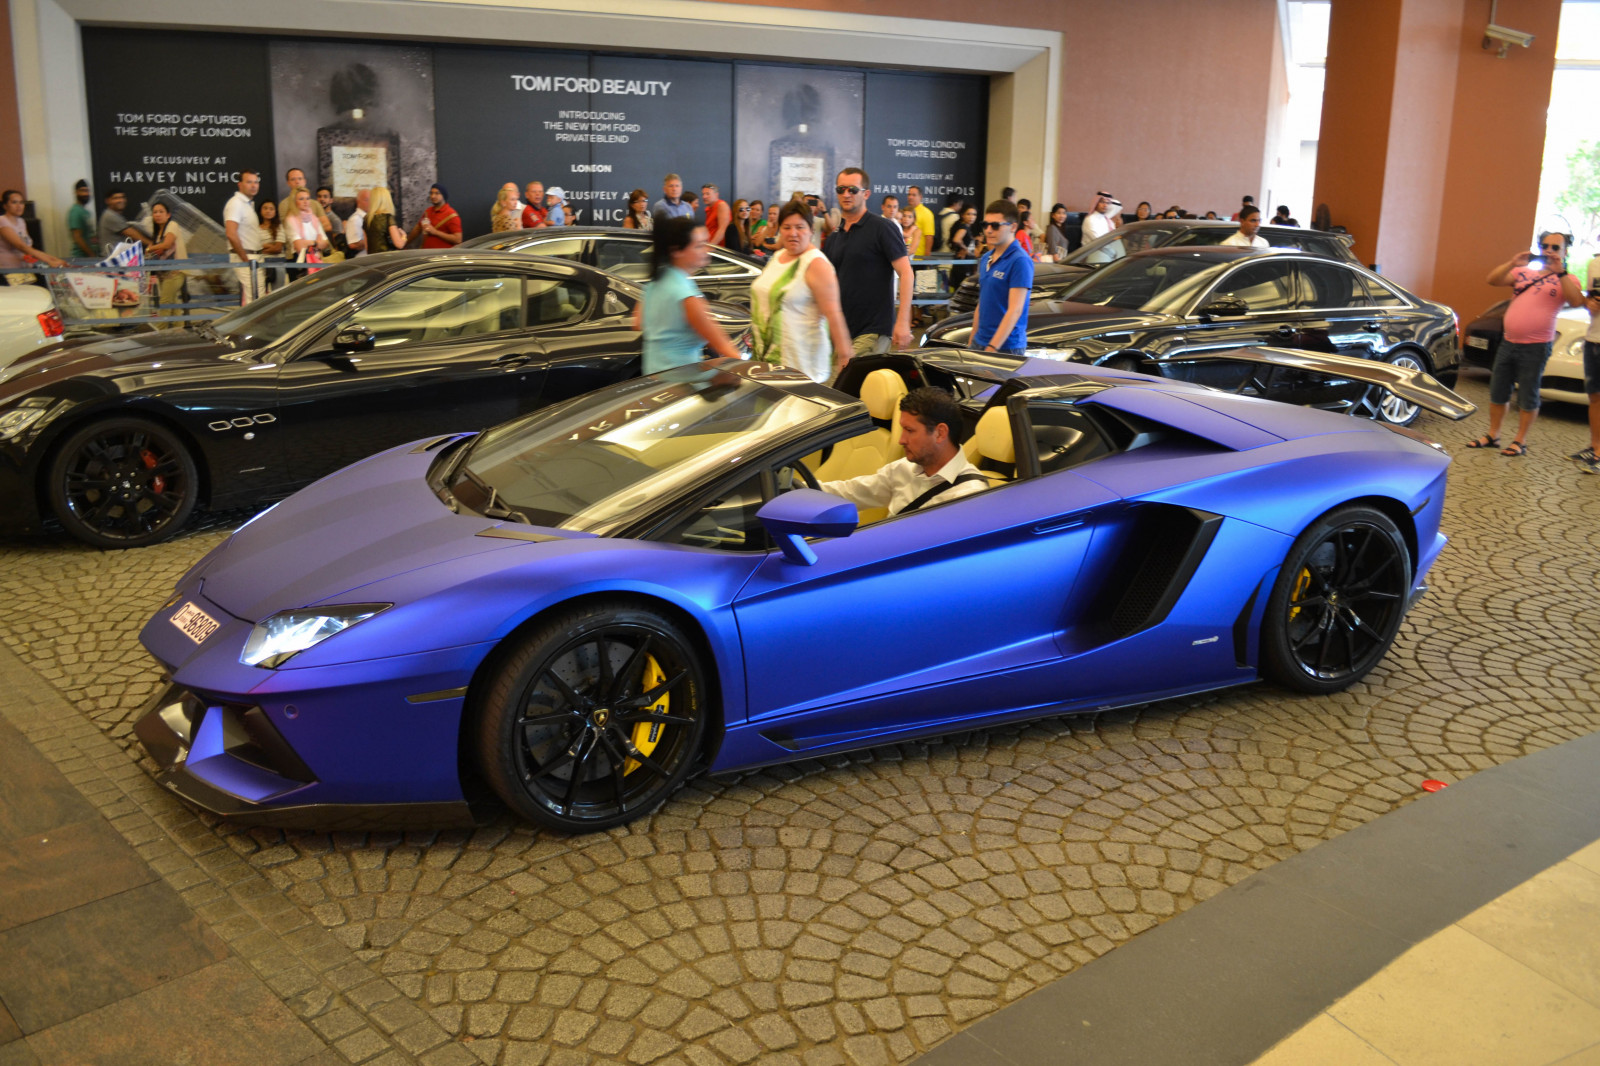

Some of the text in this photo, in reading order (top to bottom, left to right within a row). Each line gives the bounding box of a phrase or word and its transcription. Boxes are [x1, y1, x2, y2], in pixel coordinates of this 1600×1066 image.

[510, 74, 672, 96] TOM FORD BEAUTY
[116, 113, 247, 125] TOM FORD CAPTURED
[558, 110, 626, 121] INTRODUCING
[114, 126, 251, 138] THE SPIRIT OF LONDON
[543, 121, 641, 133] THE NEW TOM FORD
[887, 138, 966, 149] TOM FORD LONDON
[895, 149, 958, 159] PRIVATE BLEND
[143, 156, 227, 165] EXCLUSIVELY AT
[110, 171, 177, 183] HARVEY
[897, 172, 955, 181] EXCLUSIVELY AT
[169, 185, 206, 195] DUBAI
[183, 612, 217, 641] 96809
